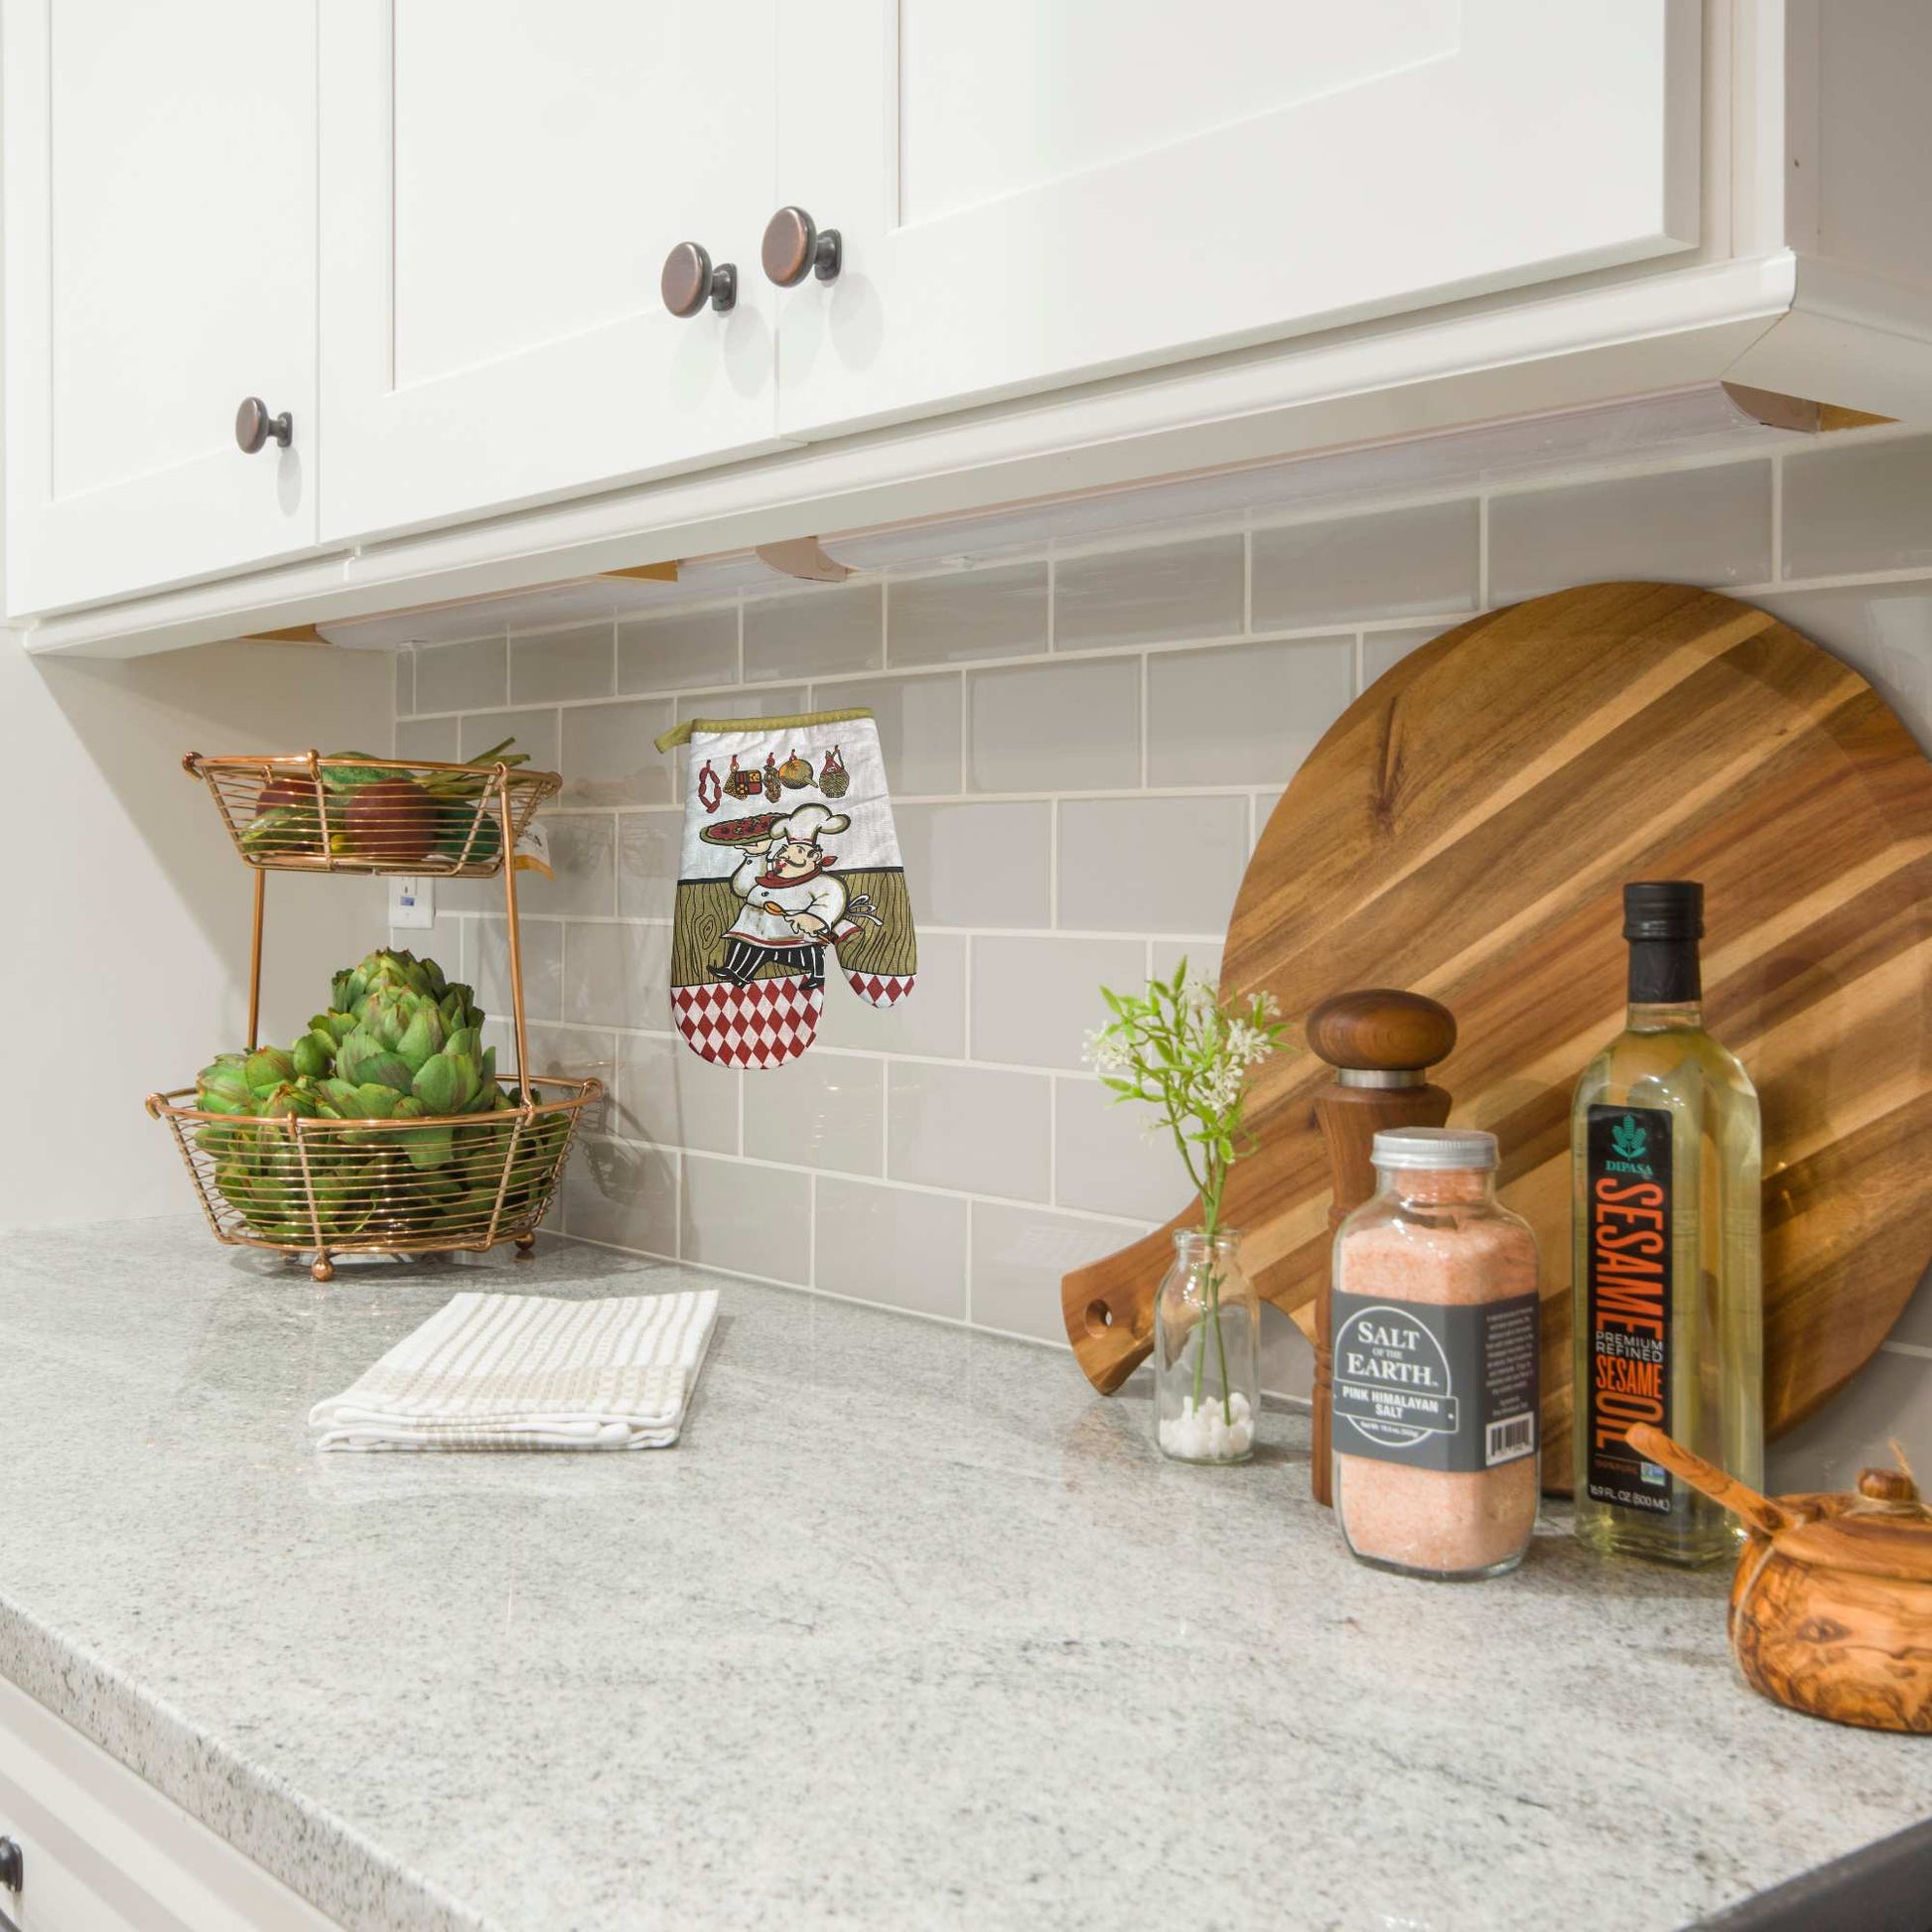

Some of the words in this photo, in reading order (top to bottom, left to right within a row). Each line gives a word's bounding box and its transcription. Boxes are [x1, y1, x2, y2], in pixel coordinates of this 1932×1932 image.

[1605, 1160, 1654, 1176] DIPASA
[1595, 1177, 1664, 1340] SESAME
[1358, 1321, 1421, 1350] SALT
[1595, 1330, 1663, 1350] PREMIUM
[1595, 1340, 1663, 1363] REFINED
[1595, 1353, 1664, 1399] SESAME
[1342, 1385, 1369, 1402] PINK
[1371, 1391, 1439, 1414] HIMALAYAN
[1375, 1403, 1404, 1419] SALT
